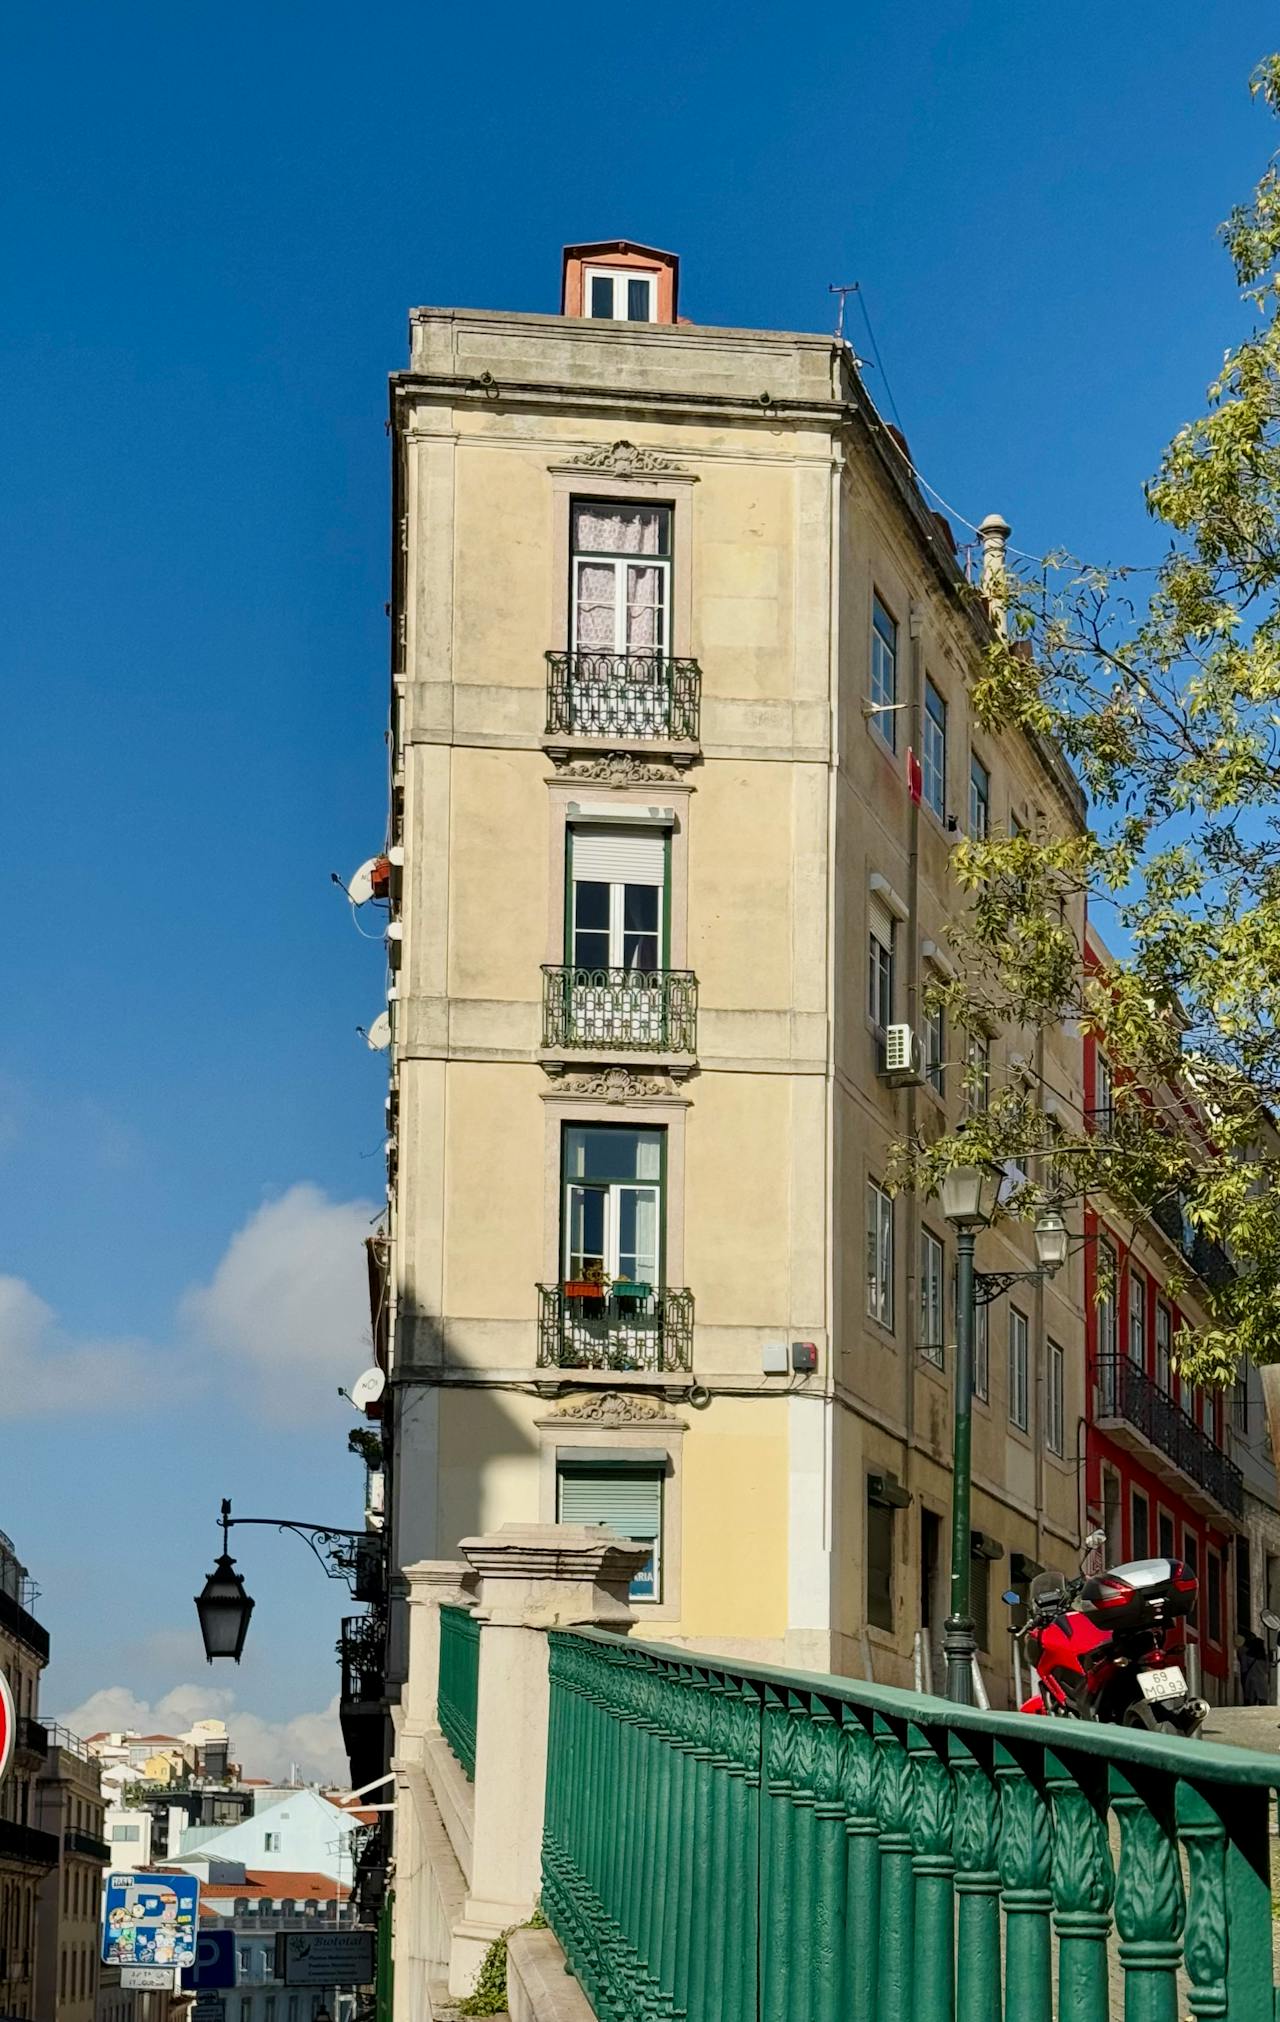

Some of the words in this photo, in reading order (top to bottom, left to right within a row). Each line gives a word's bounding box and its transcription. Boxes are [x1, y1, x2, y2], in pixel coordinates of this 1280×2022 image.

[1152, 1671, 1168, 1683] 69
[1168, 1680, 1184, 1692] 93
[122, 1883, 178, 1956] P
[192, 1938, 220, 1983] P
